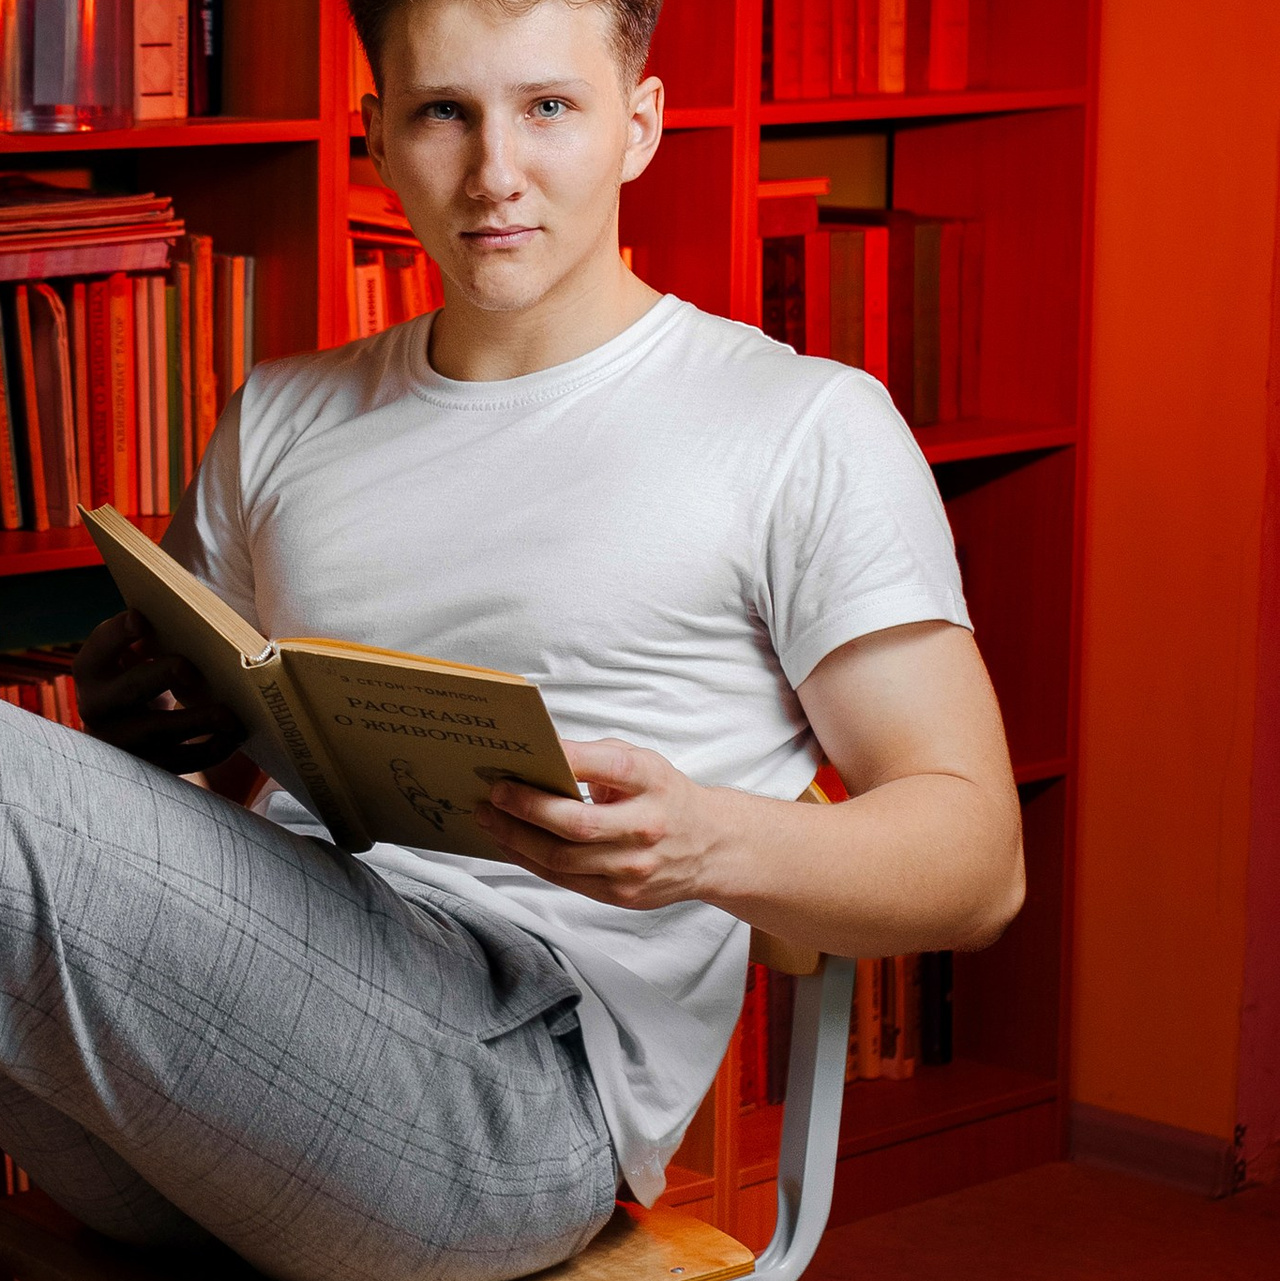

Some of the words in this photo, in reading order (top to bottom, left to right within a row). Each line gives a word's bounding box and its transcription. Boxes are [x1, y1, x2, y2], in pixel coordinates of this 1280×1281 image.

[89, 285, 106, 387] ЖИВОТНЫХ
[115, 316, 124, 354] ТАГОР
[115, 363, 126, 452] РАБИНДРАНАТ
[357, 678, 488, 703] СЕТОН-ТОМПСОН
[259, 678, 312, 763] ЖИВОТНЫХ
[346, 696, 500, 729] РАССКАЗЫ
[334, 714, 352, 726] О
[360, 717, 534, 754] ЖИВОТНЫХ
[300, 757, 318, 775] О
